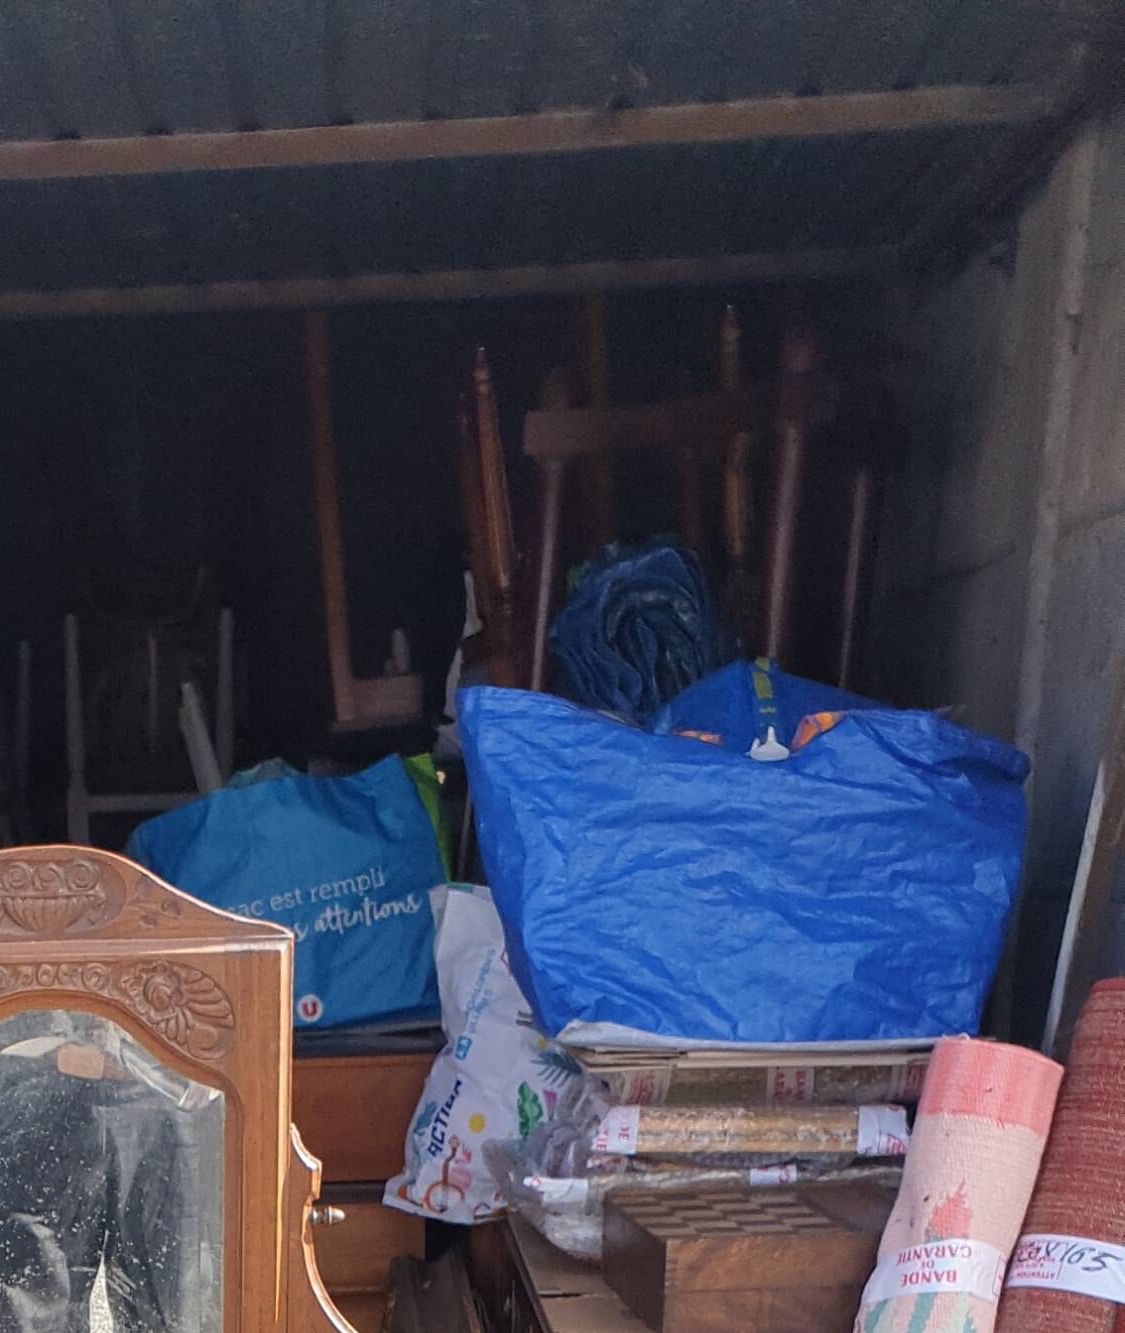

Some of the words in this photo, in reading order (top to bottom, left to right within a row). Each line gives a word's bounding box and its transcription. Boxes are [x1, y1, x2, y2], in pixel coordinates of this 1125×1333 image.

[269, 889, 304, 911] est
[309, 865, 387, 902] rempli
[920, 1260, 935, 1269] DE
[901, 1269, 957, 1287] BANDE
